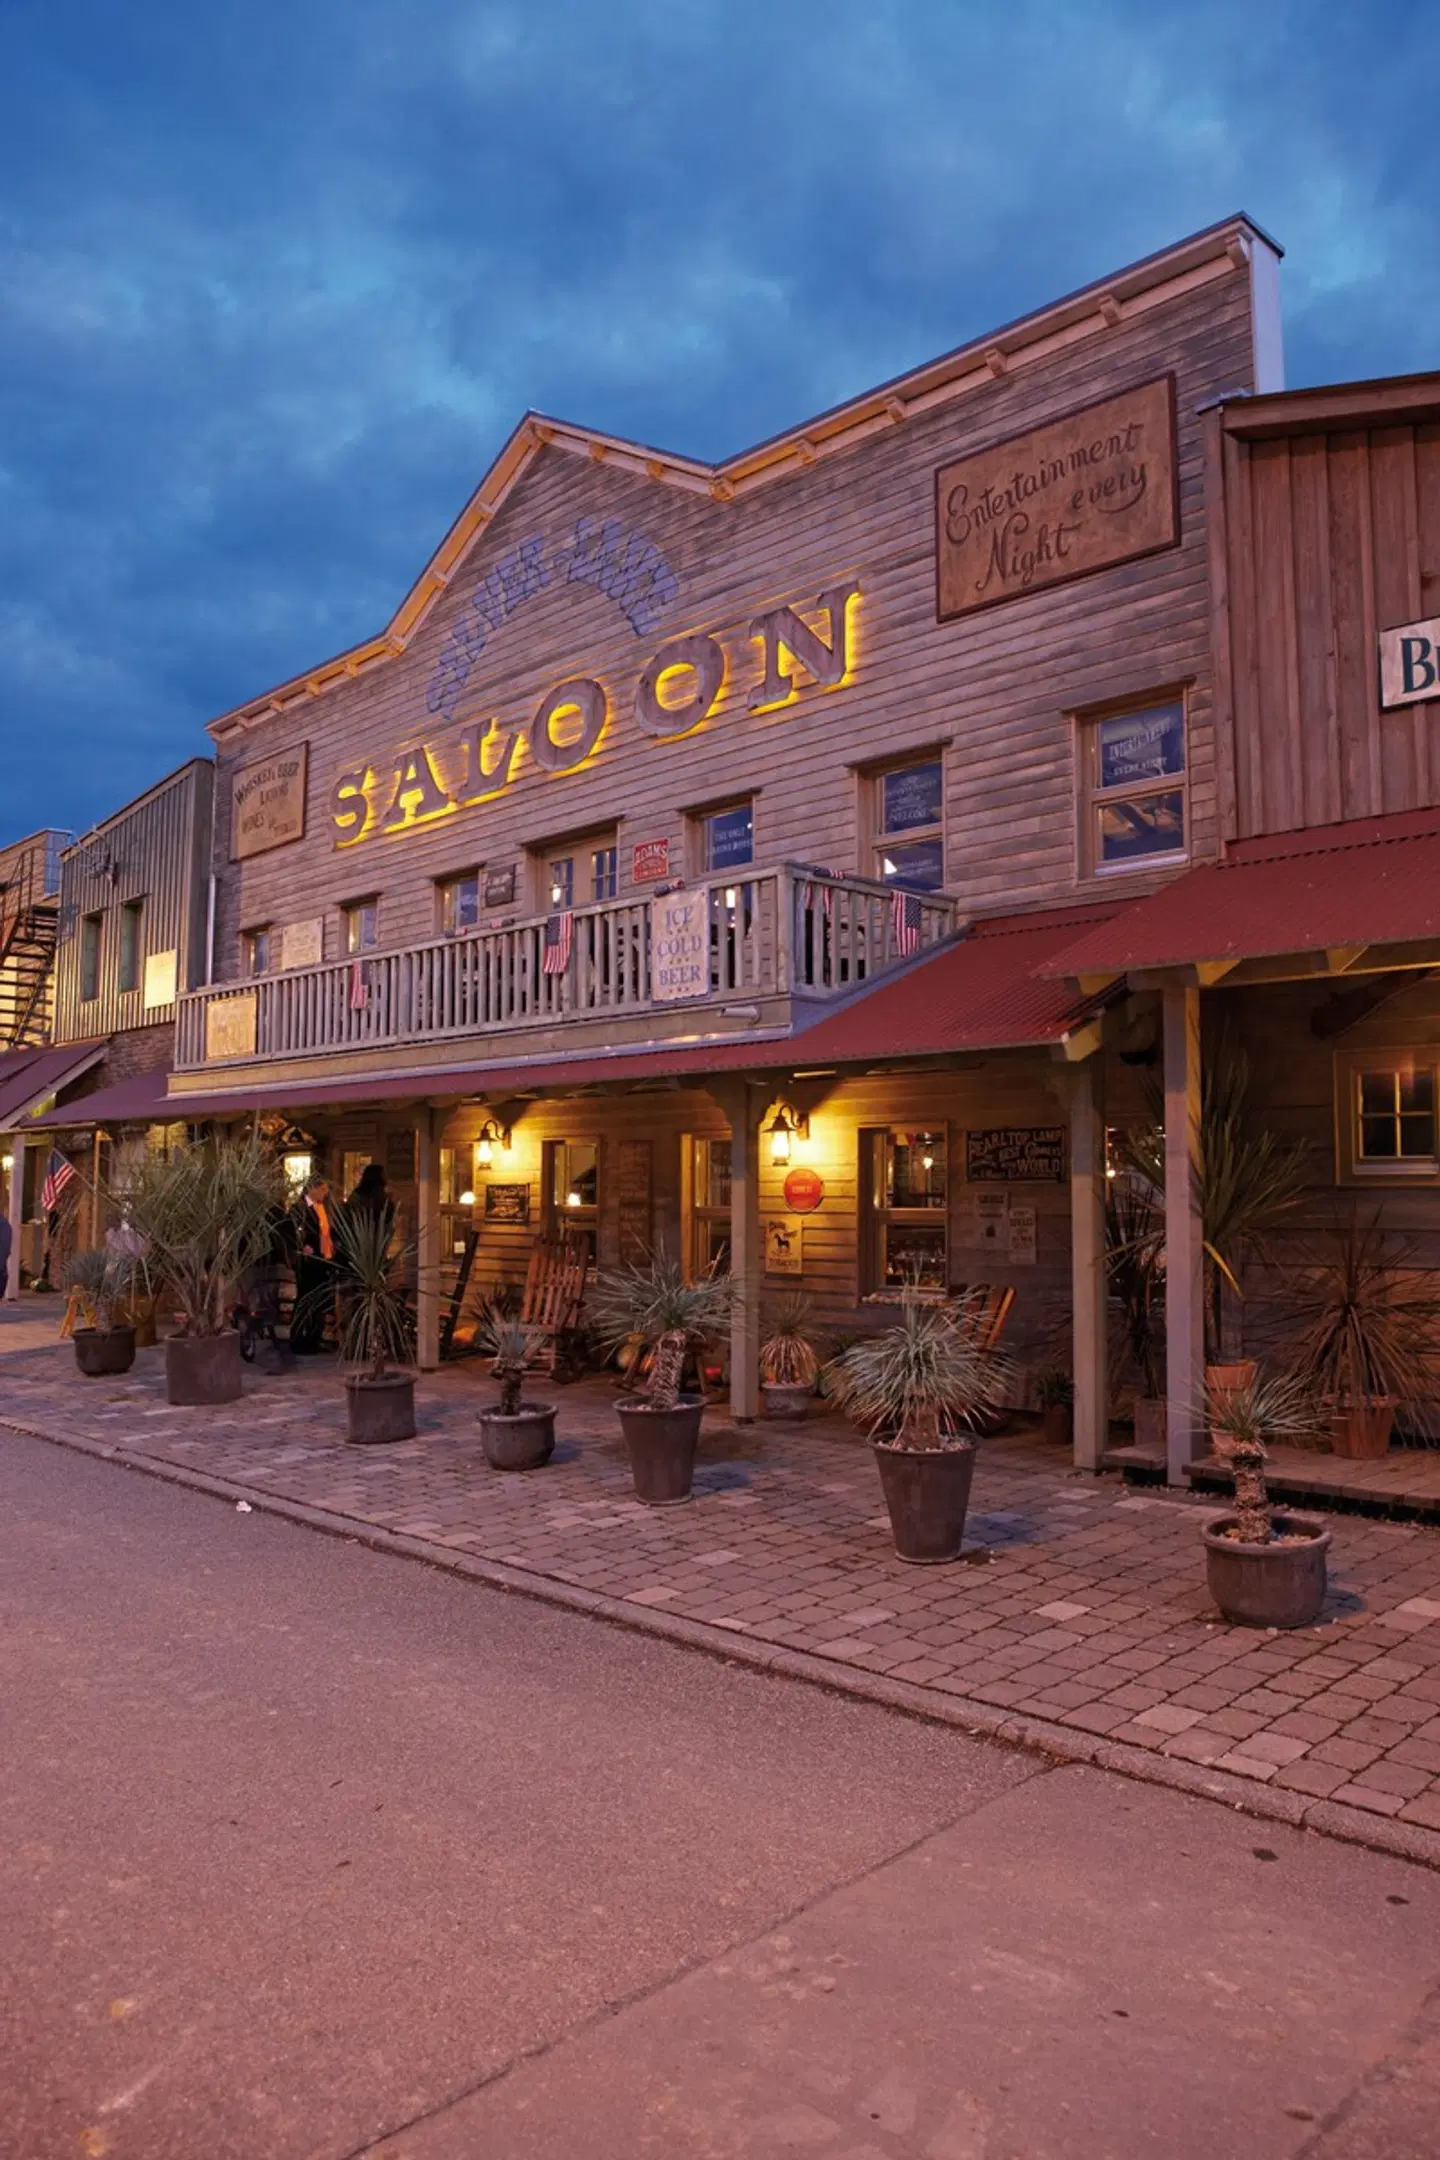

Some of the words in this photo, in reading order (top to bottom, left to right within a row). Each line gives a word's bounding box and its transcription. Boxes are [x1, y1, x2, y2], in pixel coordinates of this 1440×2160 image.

[945, 421, 1145, 544] Entertainment
[1070, 462, 1147, 514] every
[975, 511, 1083, 591] Night
[1400, 637, 1440, 694] B
[331, 581, 860, 850] SALOON
[666, 906, 693, 929] ICE
[657, 936, 702, 958] COLD
[659, 965, 701, 986] BEER
[1017, 1158, 1060, 1173] WORLD
